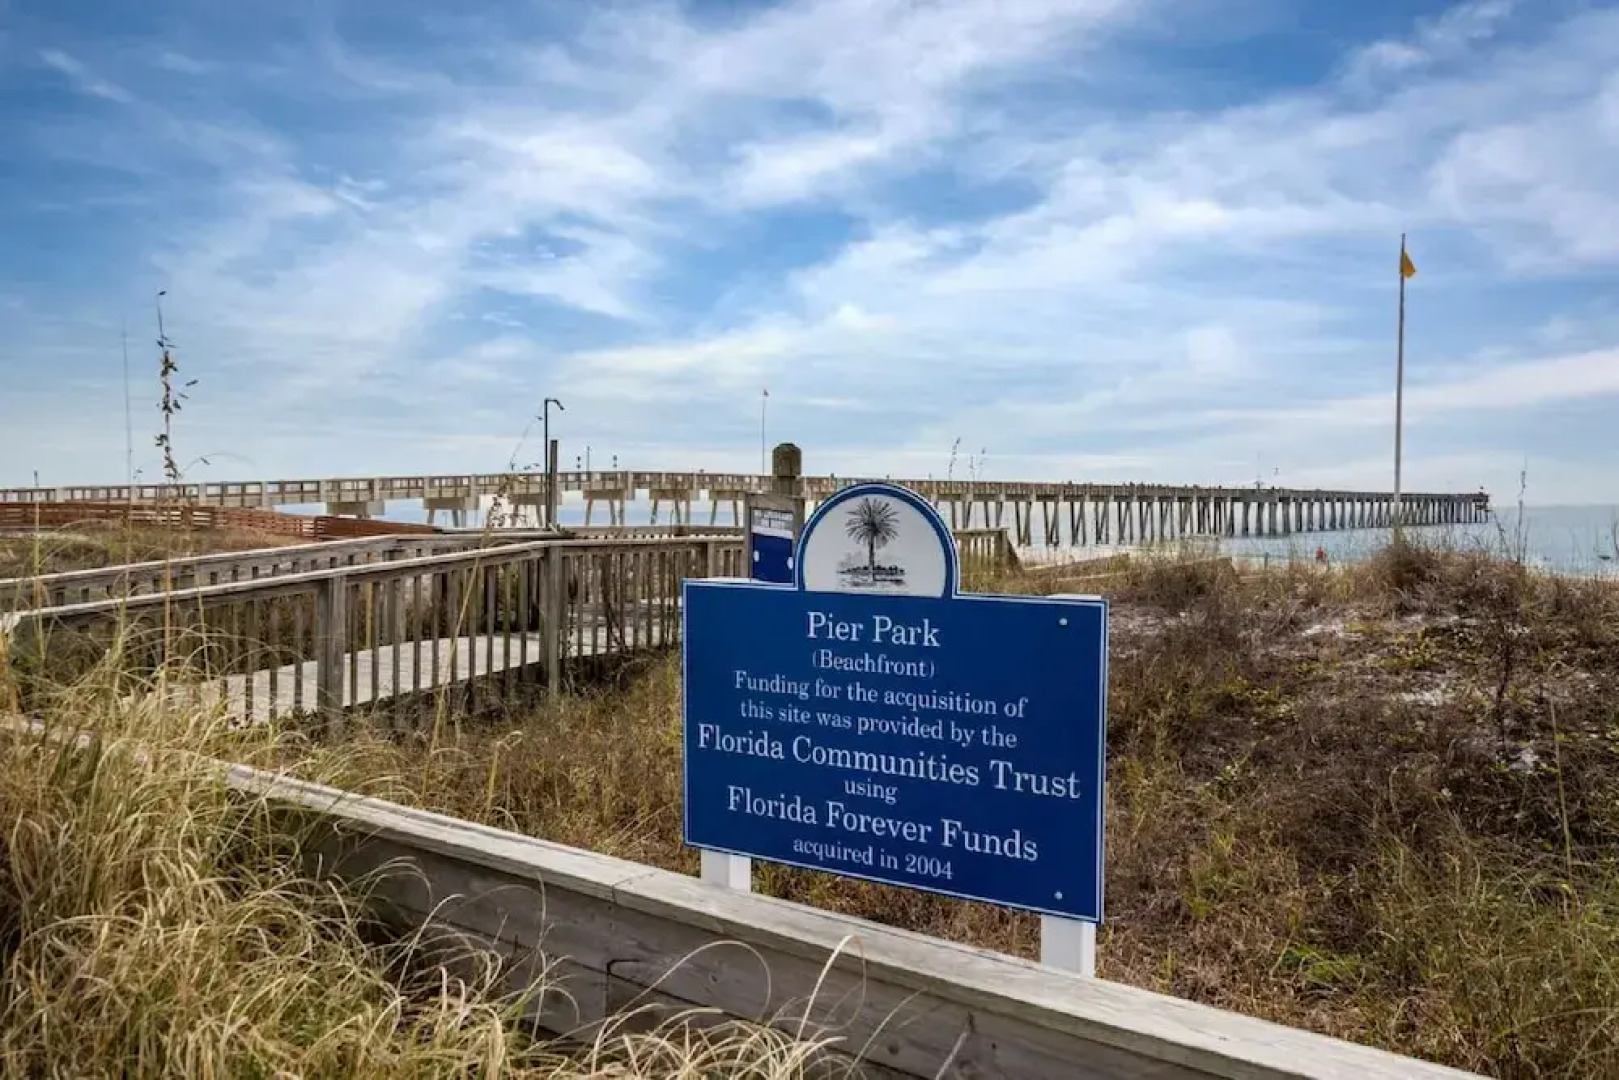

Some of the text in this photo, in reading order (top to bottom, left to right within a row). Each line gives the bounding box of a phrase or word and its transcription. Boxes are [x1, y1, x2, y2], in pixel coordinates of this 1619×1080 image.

[807, 611, 940, 647] Pier Park
[812, 649, 935, 678] (Beachfront)
[736, 670, 1028, 719] Funding for the acquisition of
[741, 699, 1017, 747] this site was provided by the
[699, 723, 1081, 799] Florida Communities Trust
[844, 781, 898, 804] using
[729, 785, 1038, 861] Florida Forever Funds
[793, 840, 954, 880] acquired in 2004
